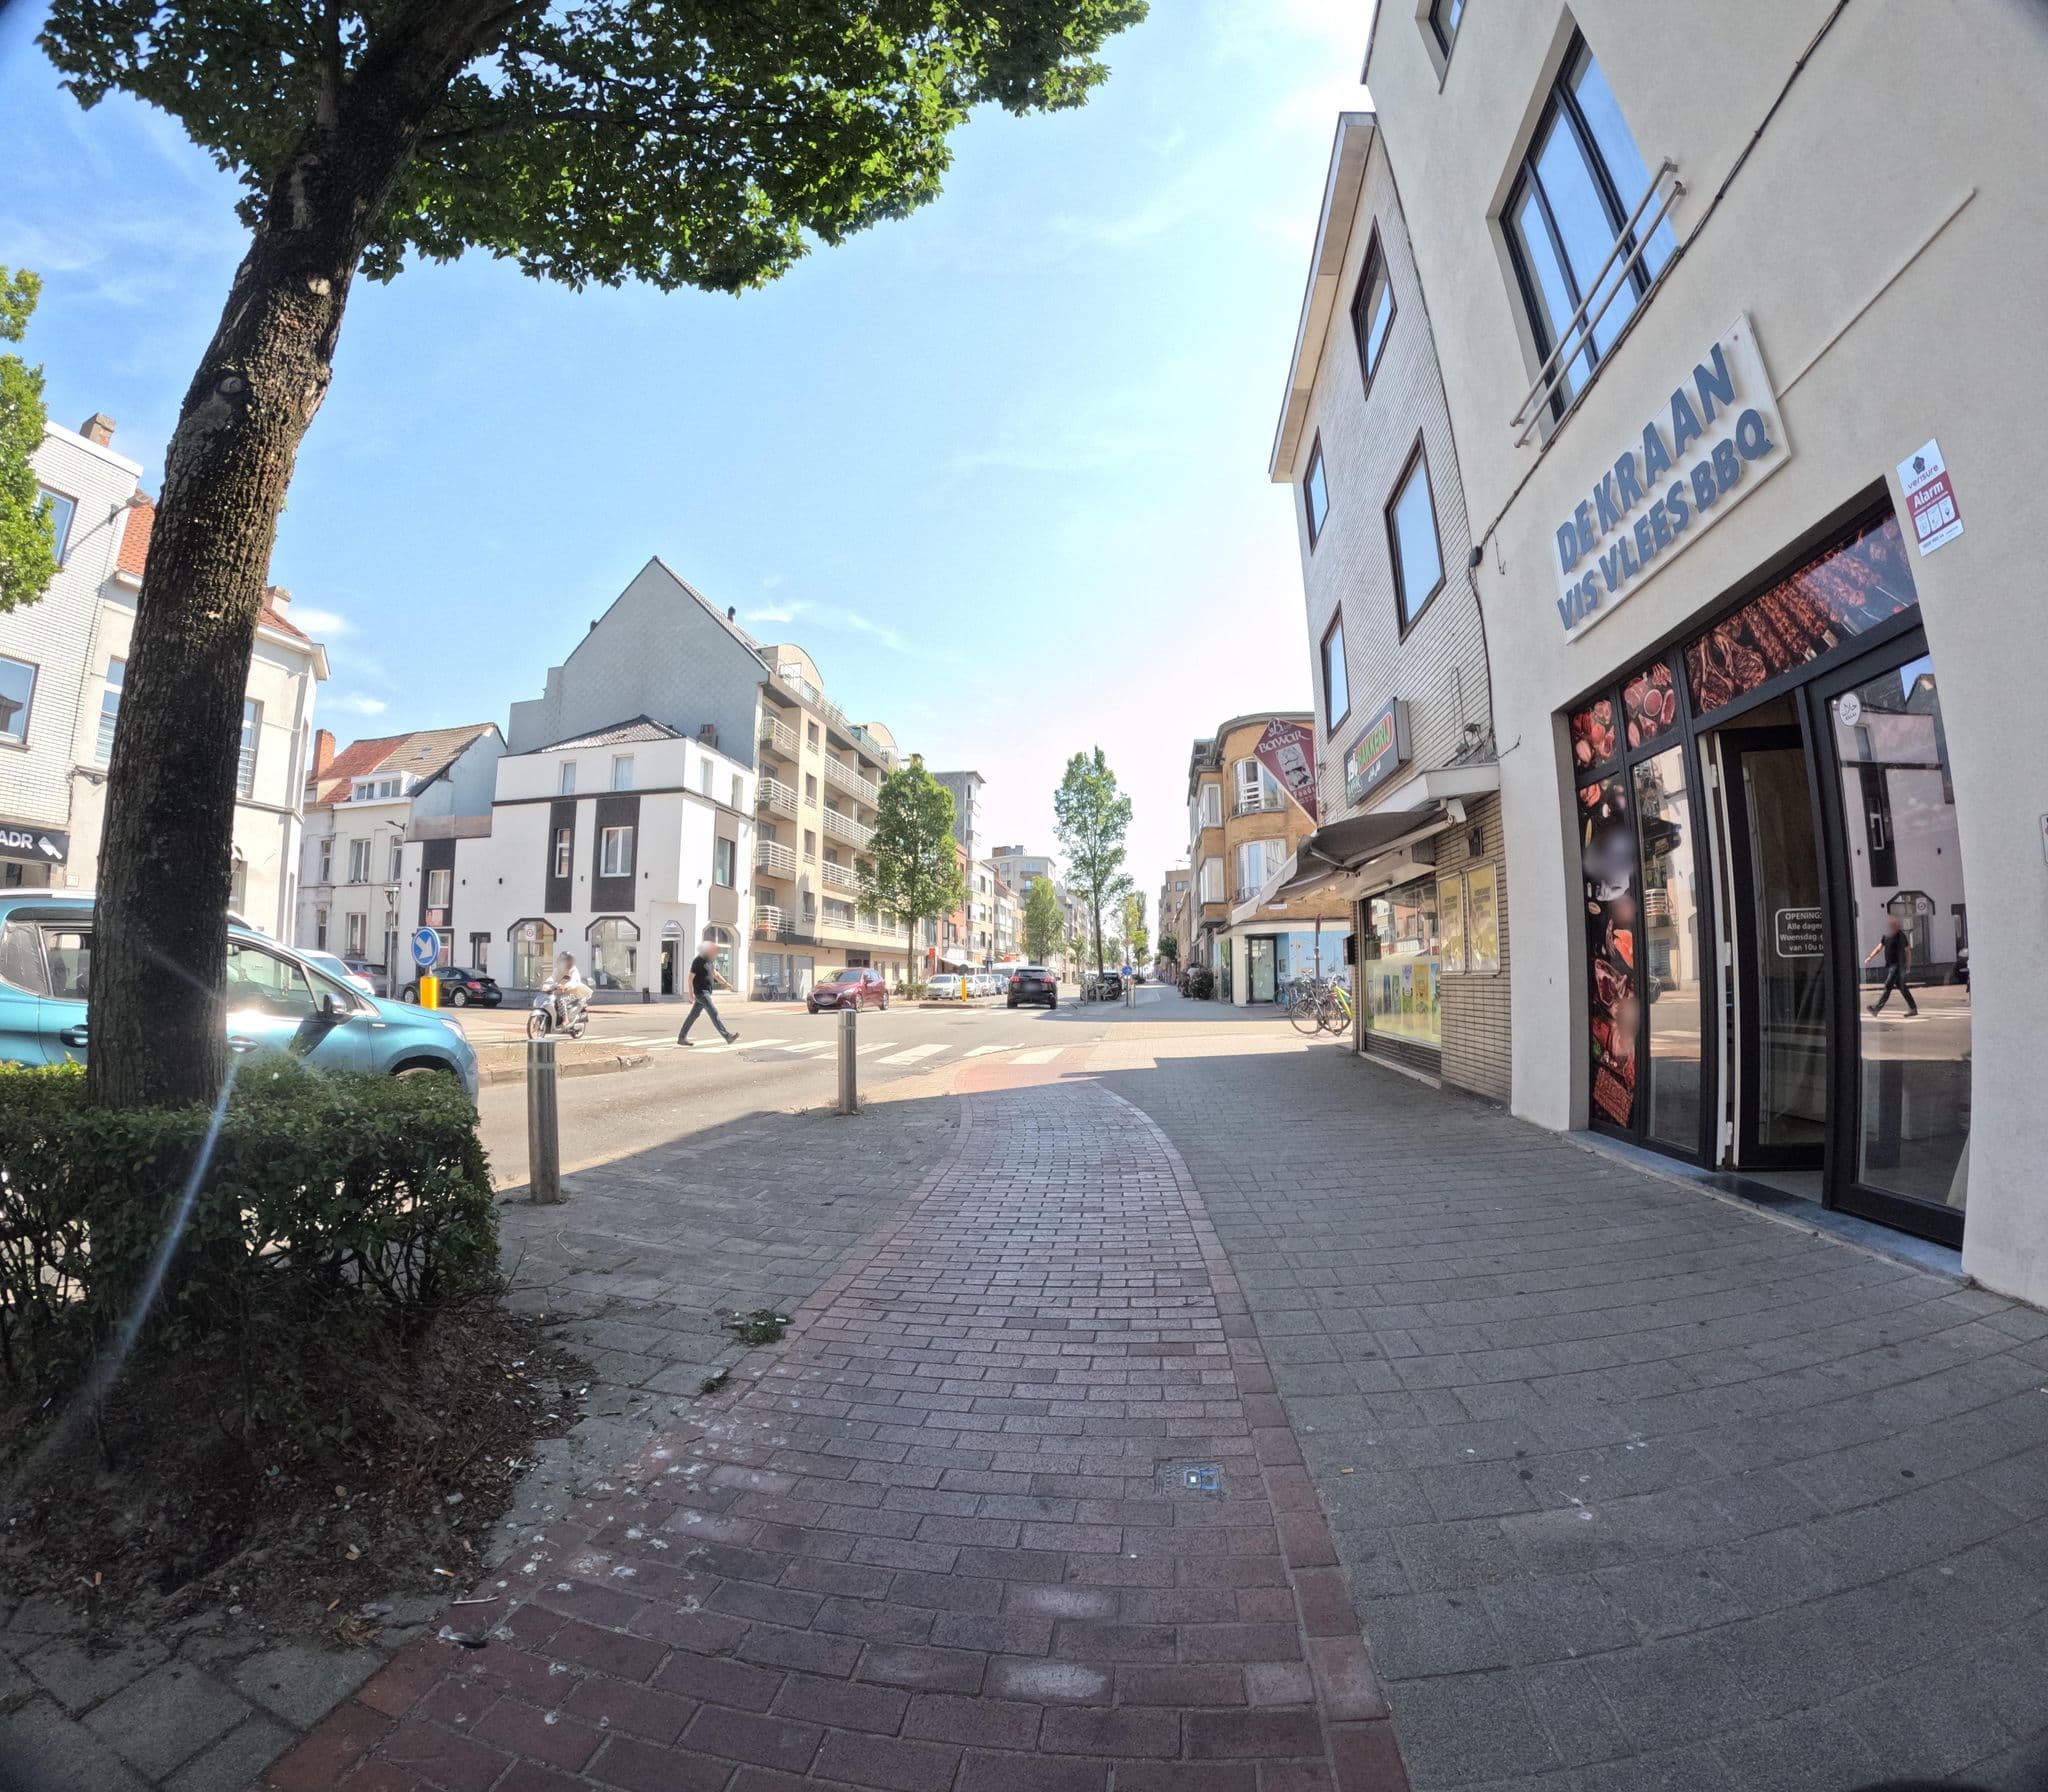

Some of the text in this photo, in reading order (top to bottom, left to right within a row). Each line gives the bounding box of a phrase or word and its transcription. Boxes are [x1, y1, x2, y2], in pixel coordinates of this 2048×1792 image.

[1593, 342, 1737, 536] KRAAN
[1908, 464, 1939, 489] verisure
[1914, 482, 1944, 509] Alarm
[1557, 408, 1774, 631] VIS VLEES BBQ
[1787, 922, 1801, 930] Alle
